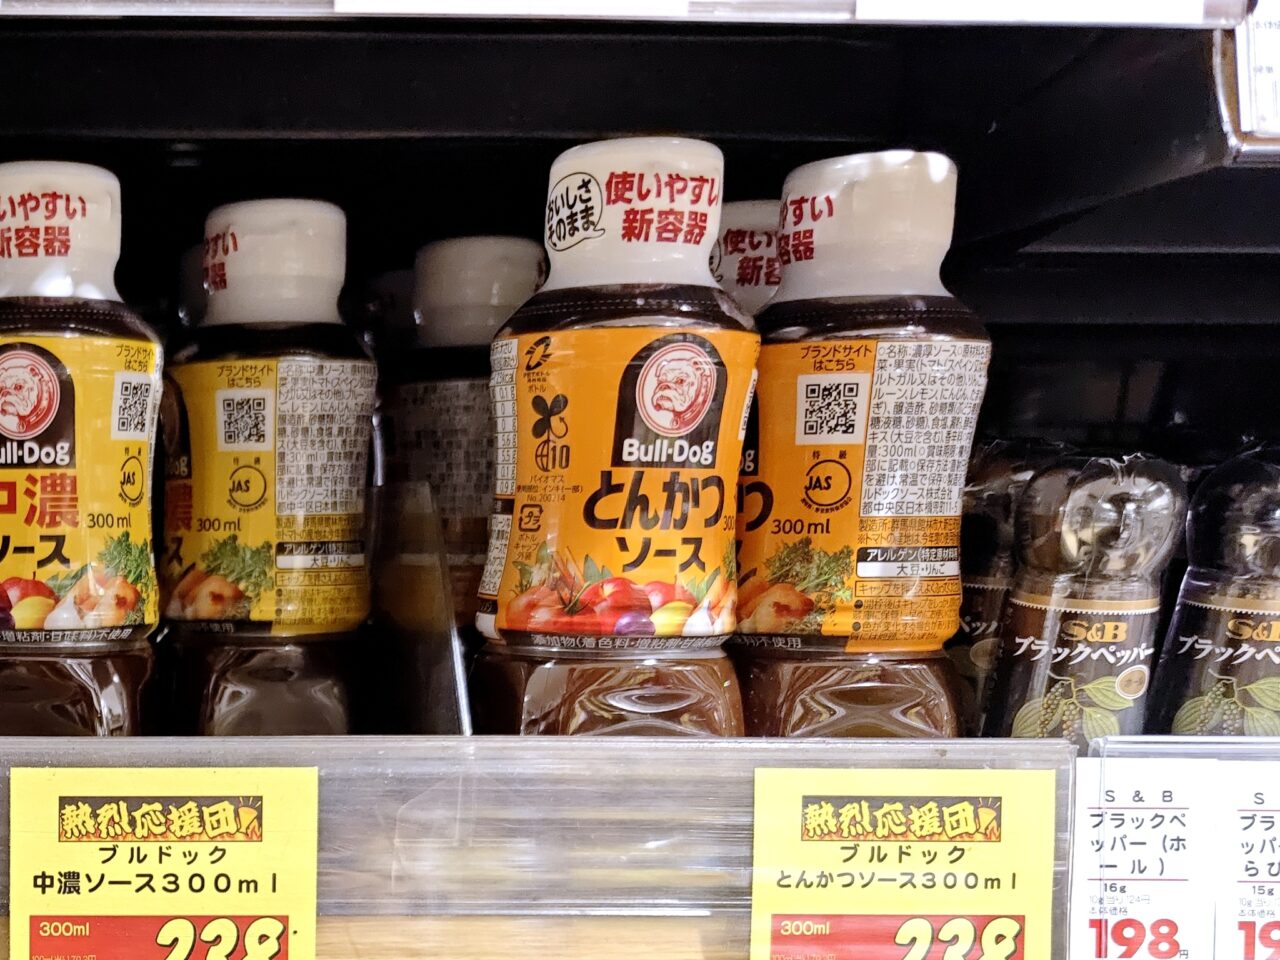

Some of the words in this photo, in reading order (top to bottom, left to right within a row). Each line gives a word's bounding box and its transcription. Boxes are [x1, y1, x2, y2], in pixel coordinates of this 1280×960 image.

[622, 208, 708, 246] 新容器
[800, 346, 872, 358] ブランドサイト
[813, 359, 856, 371] はこちら
[583, 471, 725, 531] とんかつ
[615, 536, 706, 573] ソース
[99, 845, 227, 864] ブルドック
[841, 845, 966, 864] ブルドック
[39, 922, 89, 936] 300ml
[780, 921, 830, 935] 300ml
